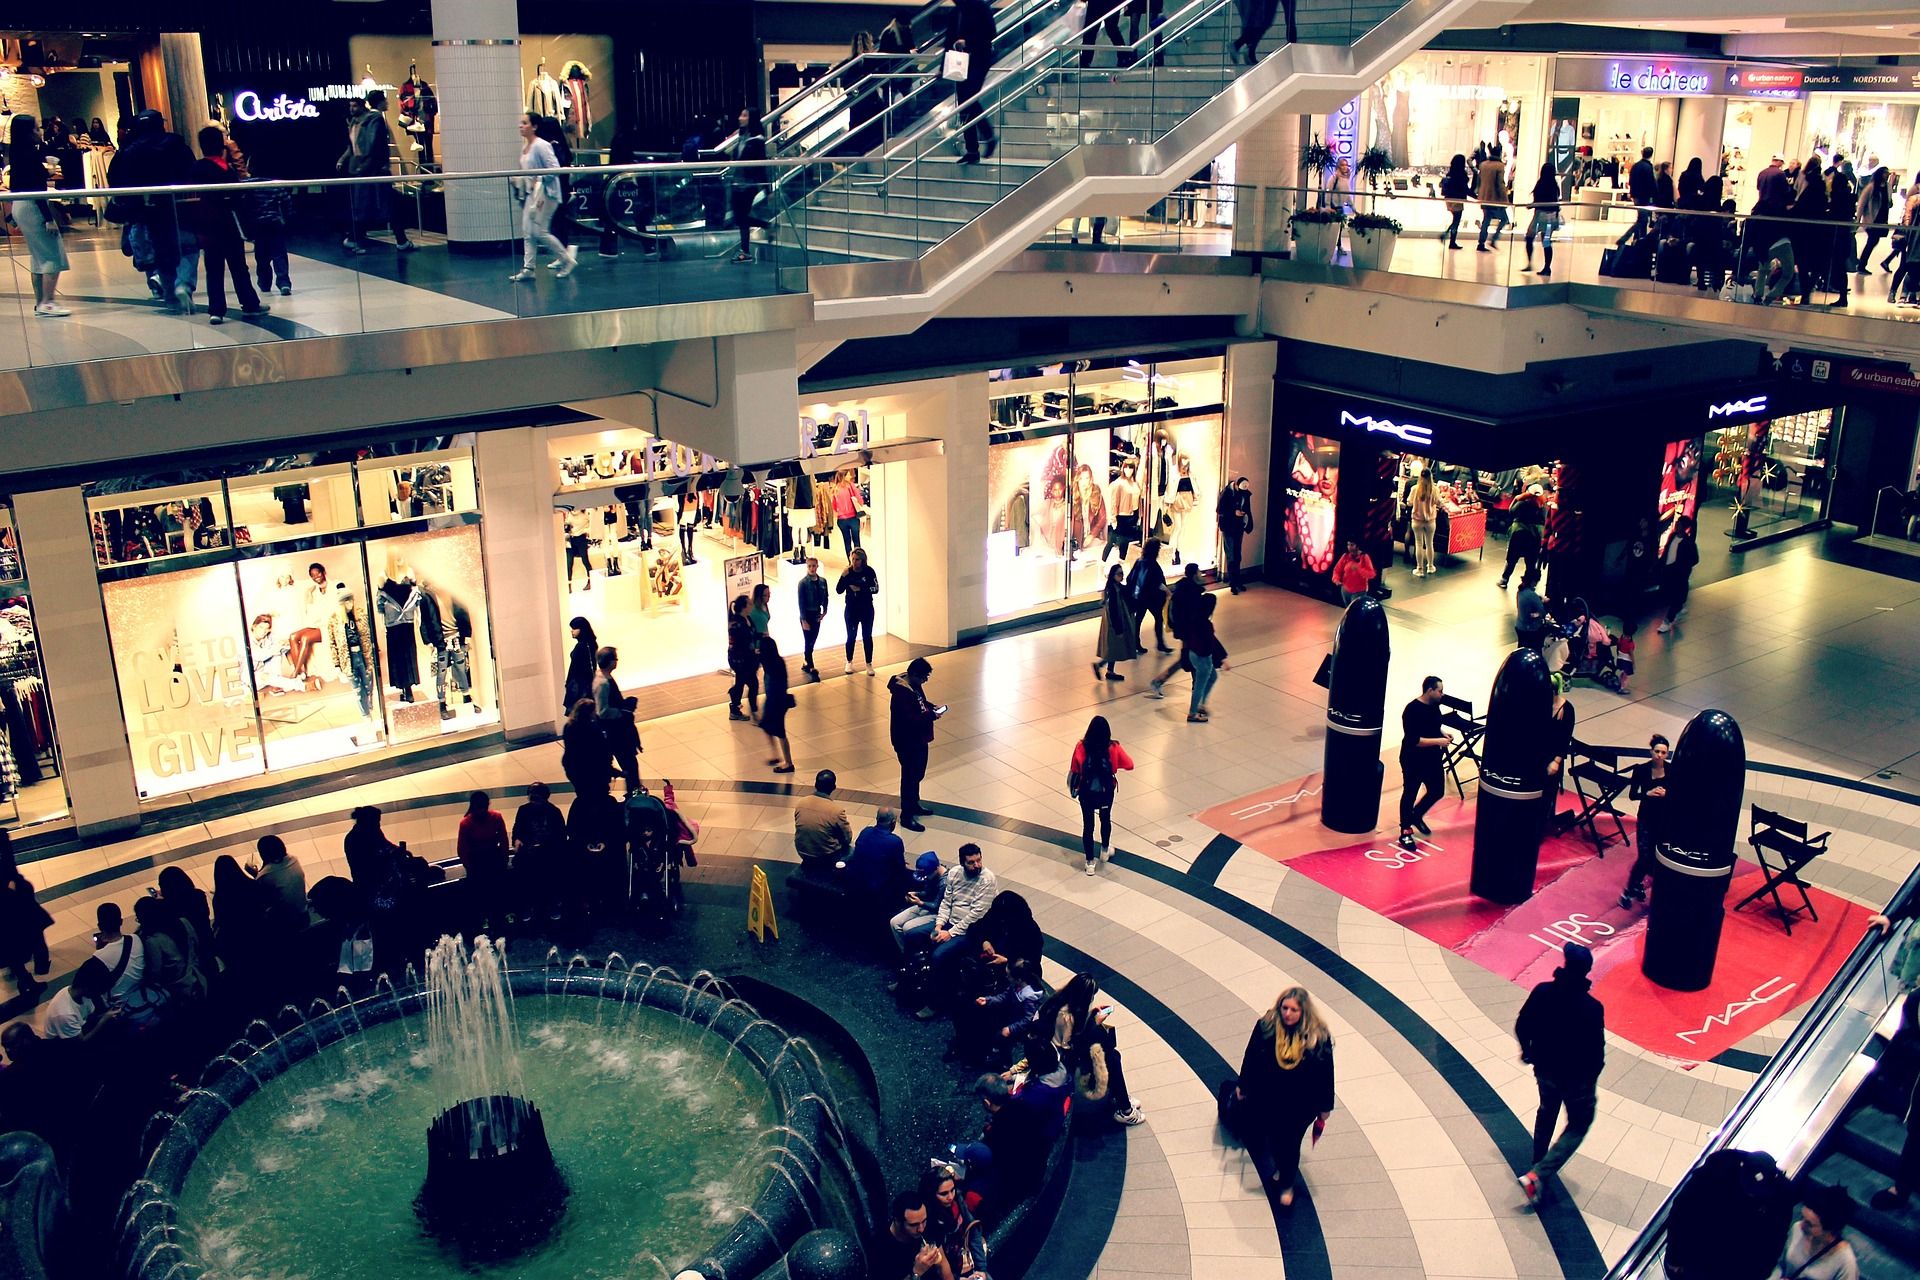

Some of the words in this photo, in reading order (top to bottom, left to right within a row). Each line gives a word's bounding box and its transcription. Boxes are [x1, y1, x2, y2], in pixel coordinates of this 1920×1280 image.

[1612, 63, 1632, 89] le
[1756, 74, 1773, 82] urban
[1803, 75, 1831, 84] Dundas
[1831, 75, 1841, 84] St.
[1852, 75, 1899, 84] NORDSTROM
[618, 189, 639, 198] Level
[578, 195, 589, 210] 2
[624, 198, 635, 214] 2
[1863, 371, 1894, 384] urban
[831, 410, 868, 455] 21
[201, 635, 237, 662] TO
[138, 660, 244, 716] LOVE
[149, 722, 255, 778] GIVE
